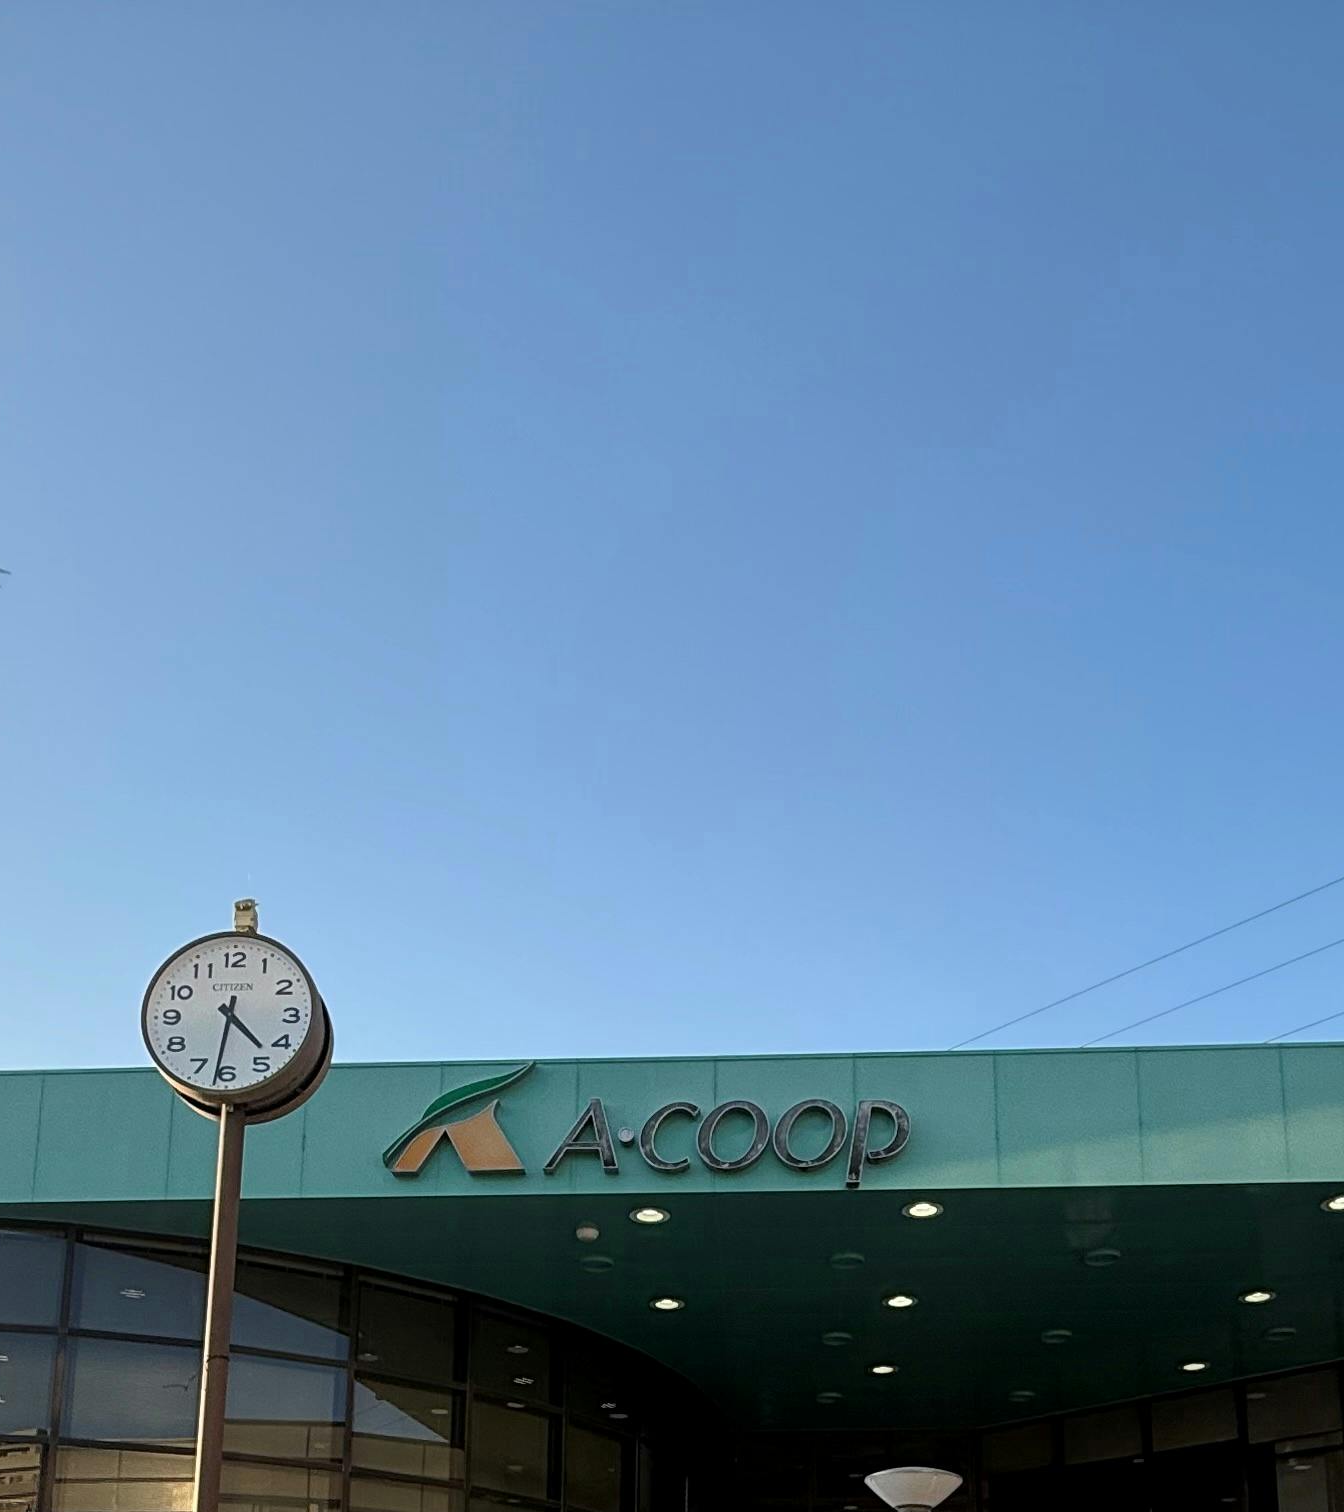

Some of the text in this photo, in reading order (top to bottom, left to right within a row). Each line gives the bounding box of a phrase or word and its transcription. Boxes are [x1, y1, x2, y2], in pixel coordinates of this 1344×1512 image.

[224, 952, 247, 968] 12
[262, 958, 268, 974] 1
[193, 963, 214, 979] 11
[170, 985, 194, 1000] 10
[212, 983, 254, 992] CITIZEN
[275, 979, 293, 996] 2
[162, 1009, 182, 1026] 9
[282, 1007, 301, 1024] 3
[167, 1036, 186, 1052] 8
[271, 1034, 292, 1050] 4
[190, 1058, 209, 1074] 7
[252, 1056, 270, 1073] 5
[217, 1065, 236, 1082] 6
